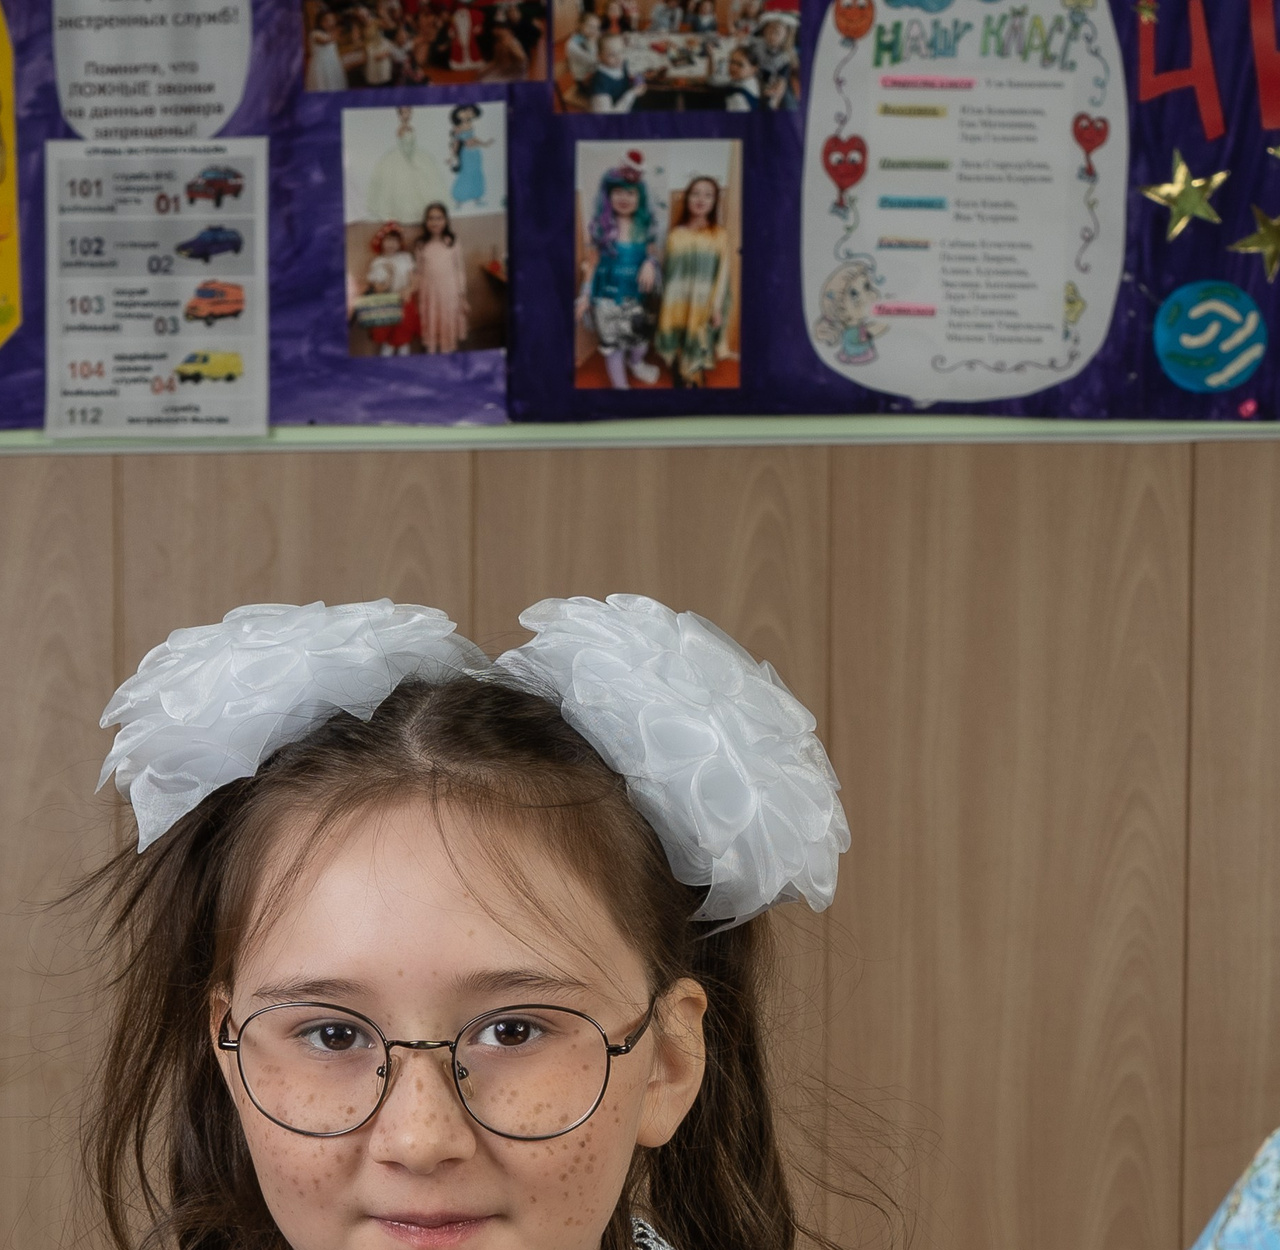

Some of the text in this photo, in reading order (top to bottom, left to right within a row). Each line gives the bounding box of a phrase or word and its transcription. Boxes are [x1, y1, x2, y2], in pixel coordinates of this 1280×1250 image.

[169, 61, 199, 74] что
[68, 178, 104, 199] 101
[155, 194, 181, 214] 01
[69, 237, 106, 256] 102
[147, 255, 175, 275] 02
[68, 295, 106, 316] 103
[154, 316, 181, 336] 03
[68, 361, 106, 380] 104
[150, 375, 177, 396] 04
[66, 406, 102, 425] 112
